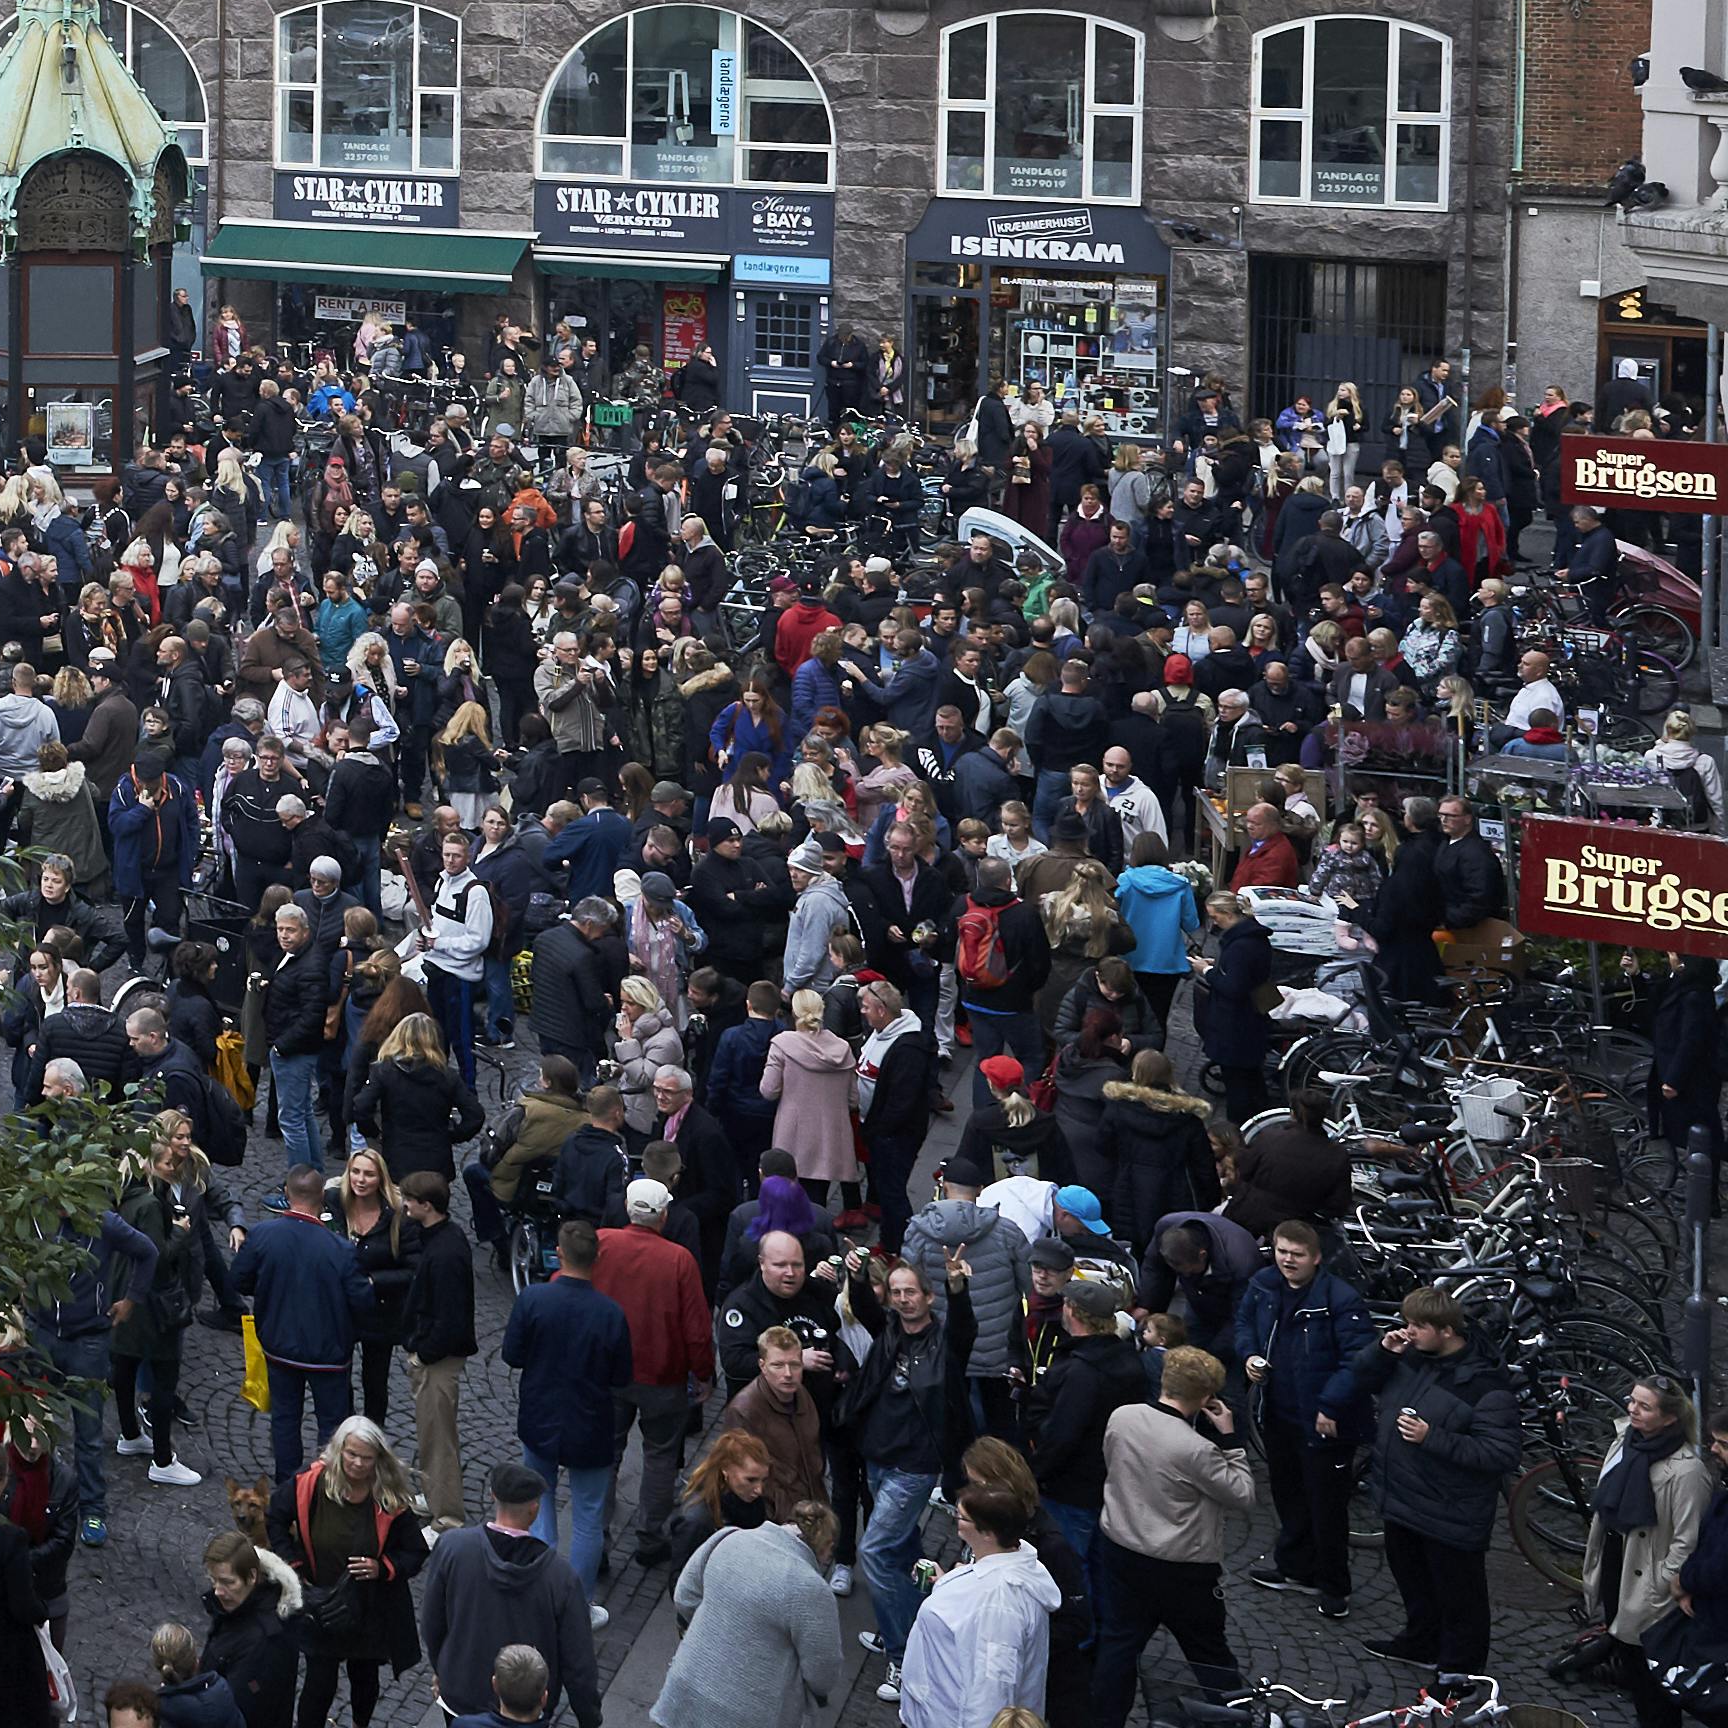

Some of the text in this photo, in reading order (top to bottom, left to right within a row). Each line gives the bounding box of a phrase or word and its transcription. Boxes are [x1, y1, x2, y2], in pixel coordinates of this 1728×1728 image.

[716, 57, 734, 128] tandlægerne
[342, 142, 391, 152] TANDLÆGE
[656, 153, 710, 164] TANDLÆGE
[1009, 166, 1068, 177] TANDLÆGE
[1315, 171, 1381, 182] TANDLÆGE
[293, 176, 444, 207] STAR CYKLER
[328, 201, 402, 214] VÆRKSTED
[556, 187, 720, 219] STAR CYKLER
[751, 195, 811, 213] Hanne
[594, 214, 672, 228] VÆRKSTED
[766, 212, 801, 229] BAY
[996, 215, 1089, 233] KRÆMMERHUSET
[950, 235, 1125, 264] ISENKRAM
[743, 260, 800, 274] tandlægerne
[317, 297, 405, 313] RENT A BIKE
[1596, 449, 1646, 469] Super
[1575, 458, 1718, 499] Brugsen
[1580, 845, 1663, 878] Super
